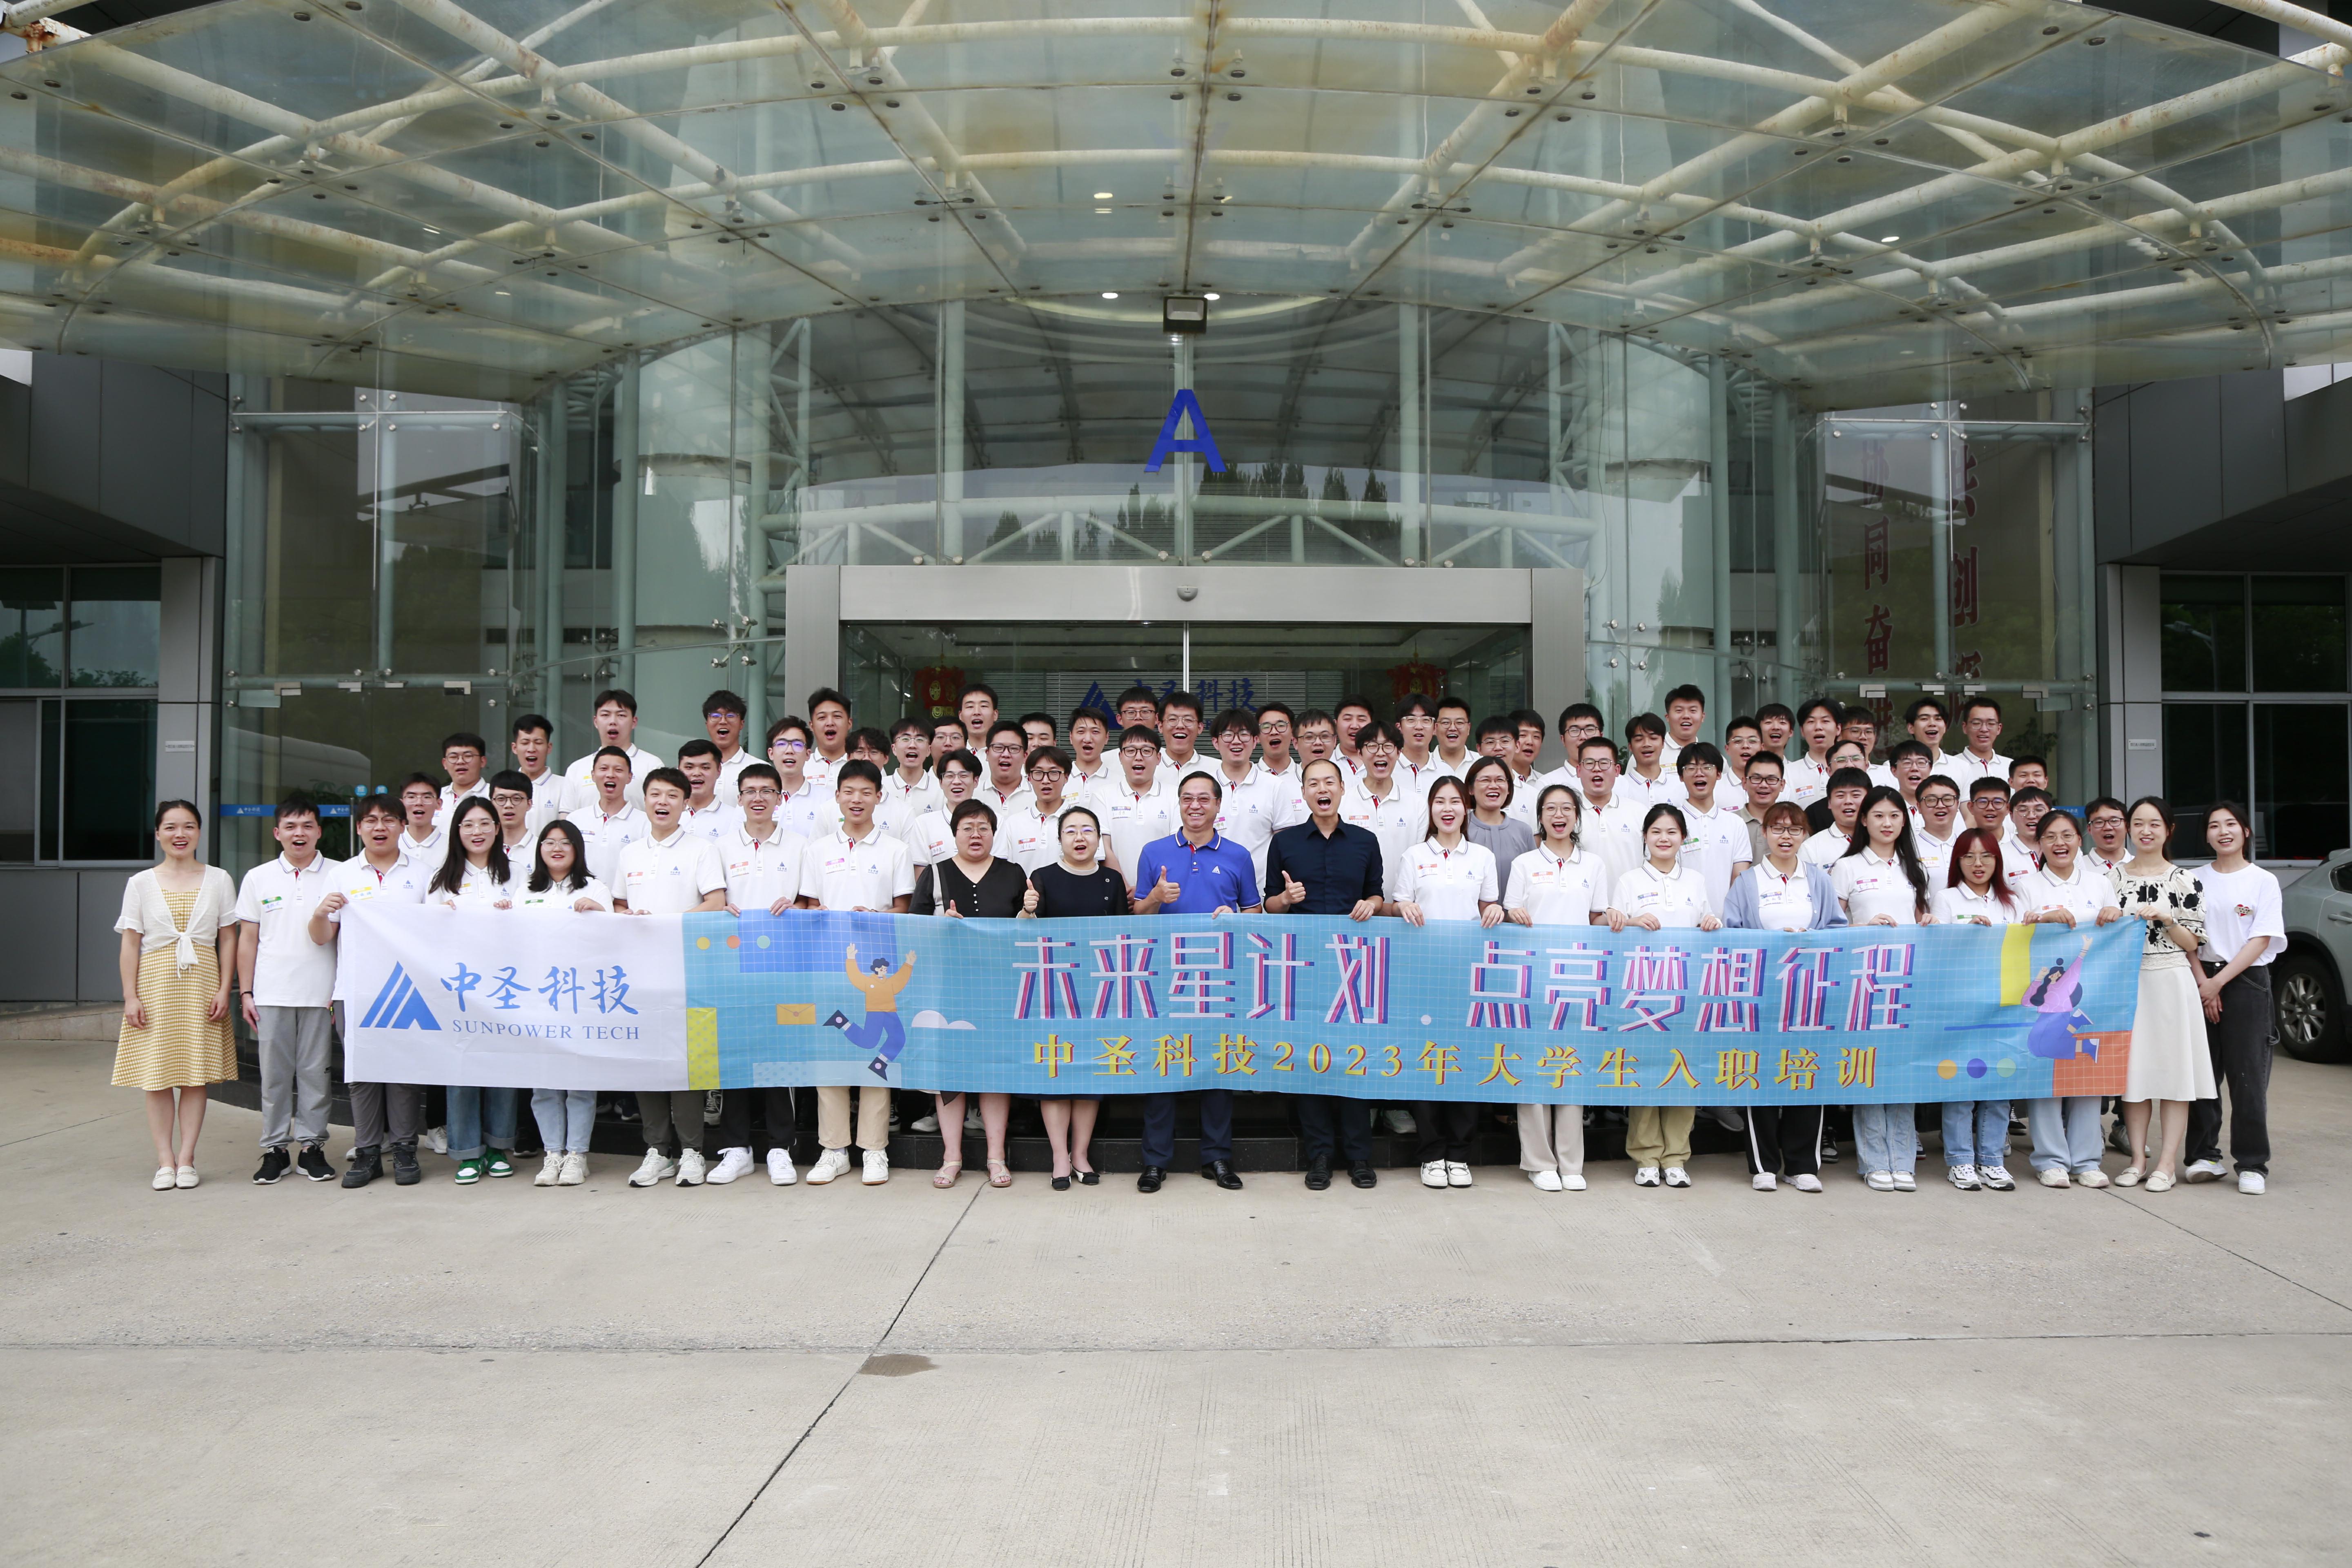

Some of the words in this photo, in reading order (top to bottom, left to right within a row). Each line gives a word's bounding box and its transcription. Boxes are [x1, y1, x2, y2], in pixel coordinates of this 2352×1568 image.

[1144, 389, 1227, 472] A
[441, 962, 639, 1015] 中圣科技
[453, 1020, 572, 1038] SUNPOWER
[583, 1026, 639, 1040] TECH
[1034, 1034, 1877, 1089] 中圣科技2023年大学生入职培训
